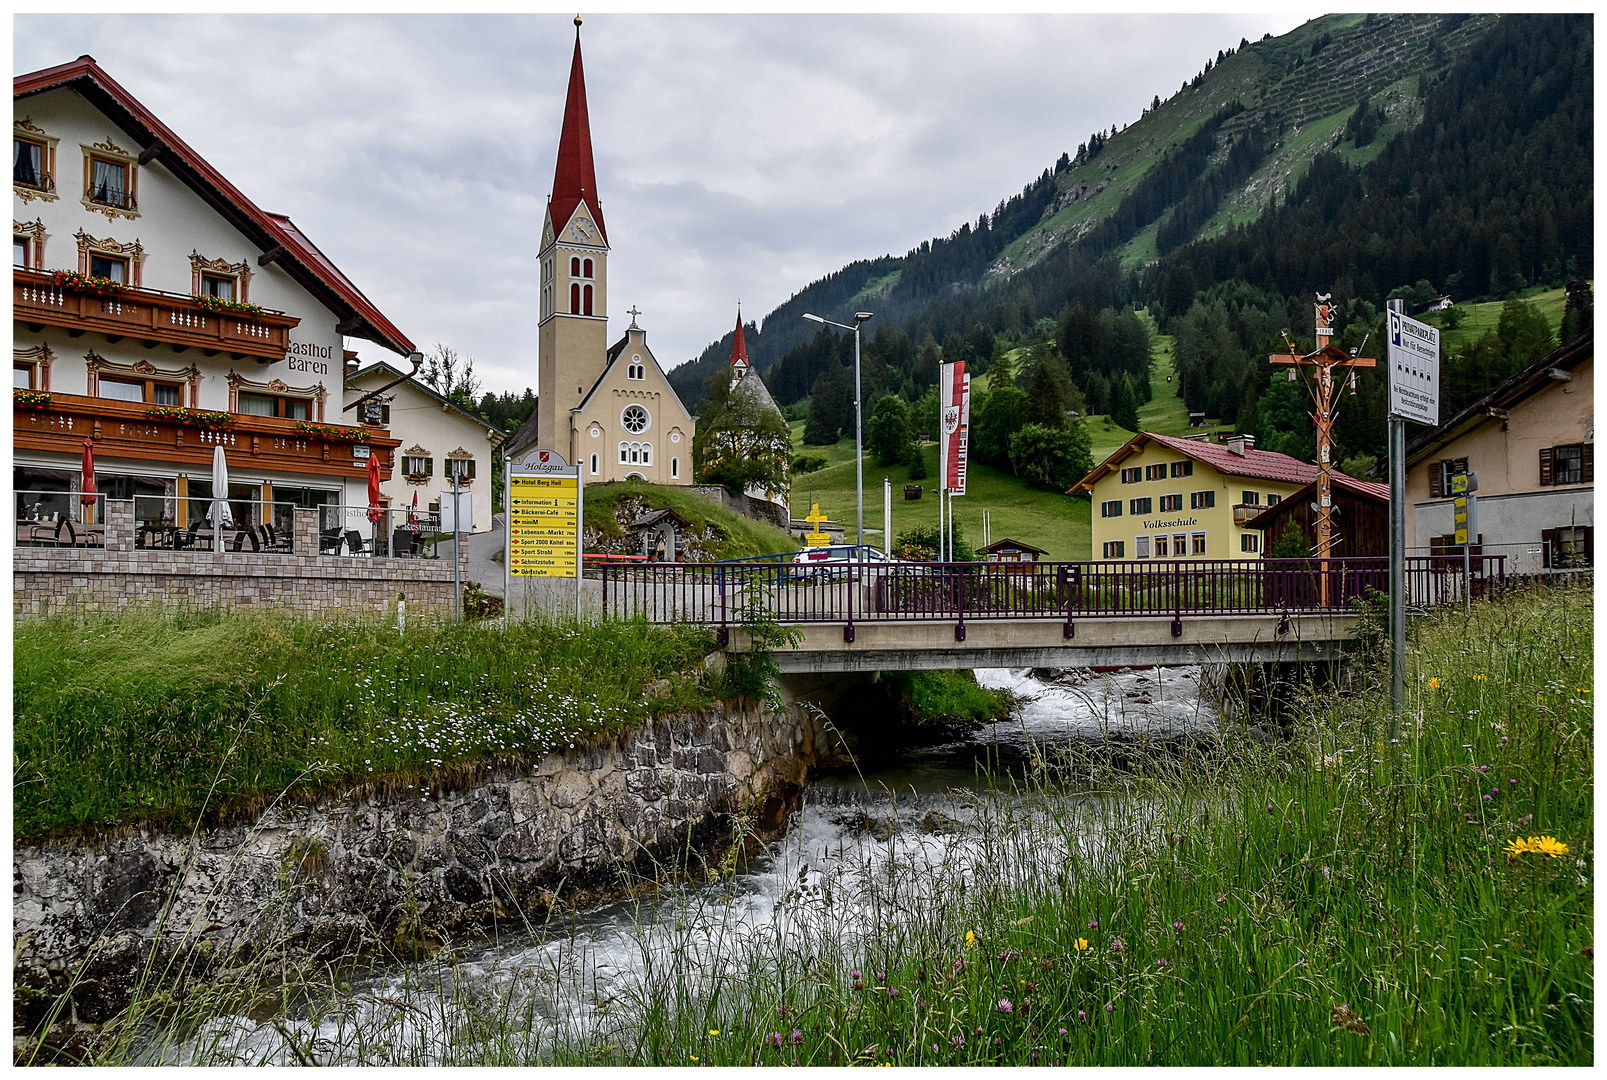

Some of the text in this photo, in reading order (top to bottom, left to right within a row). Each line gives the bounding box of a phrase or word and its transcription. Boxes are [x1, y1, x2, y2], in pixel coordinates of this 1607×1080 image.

[1392, 316, 1400, 342] P
[1402, 320, 1436, 343] PRIVATPARKPLATZ
[288, 356, 328, 375] Bären
[524, 462, 564, 473] Holzgau
[1143, 517, 1197, 529] Volksschule
